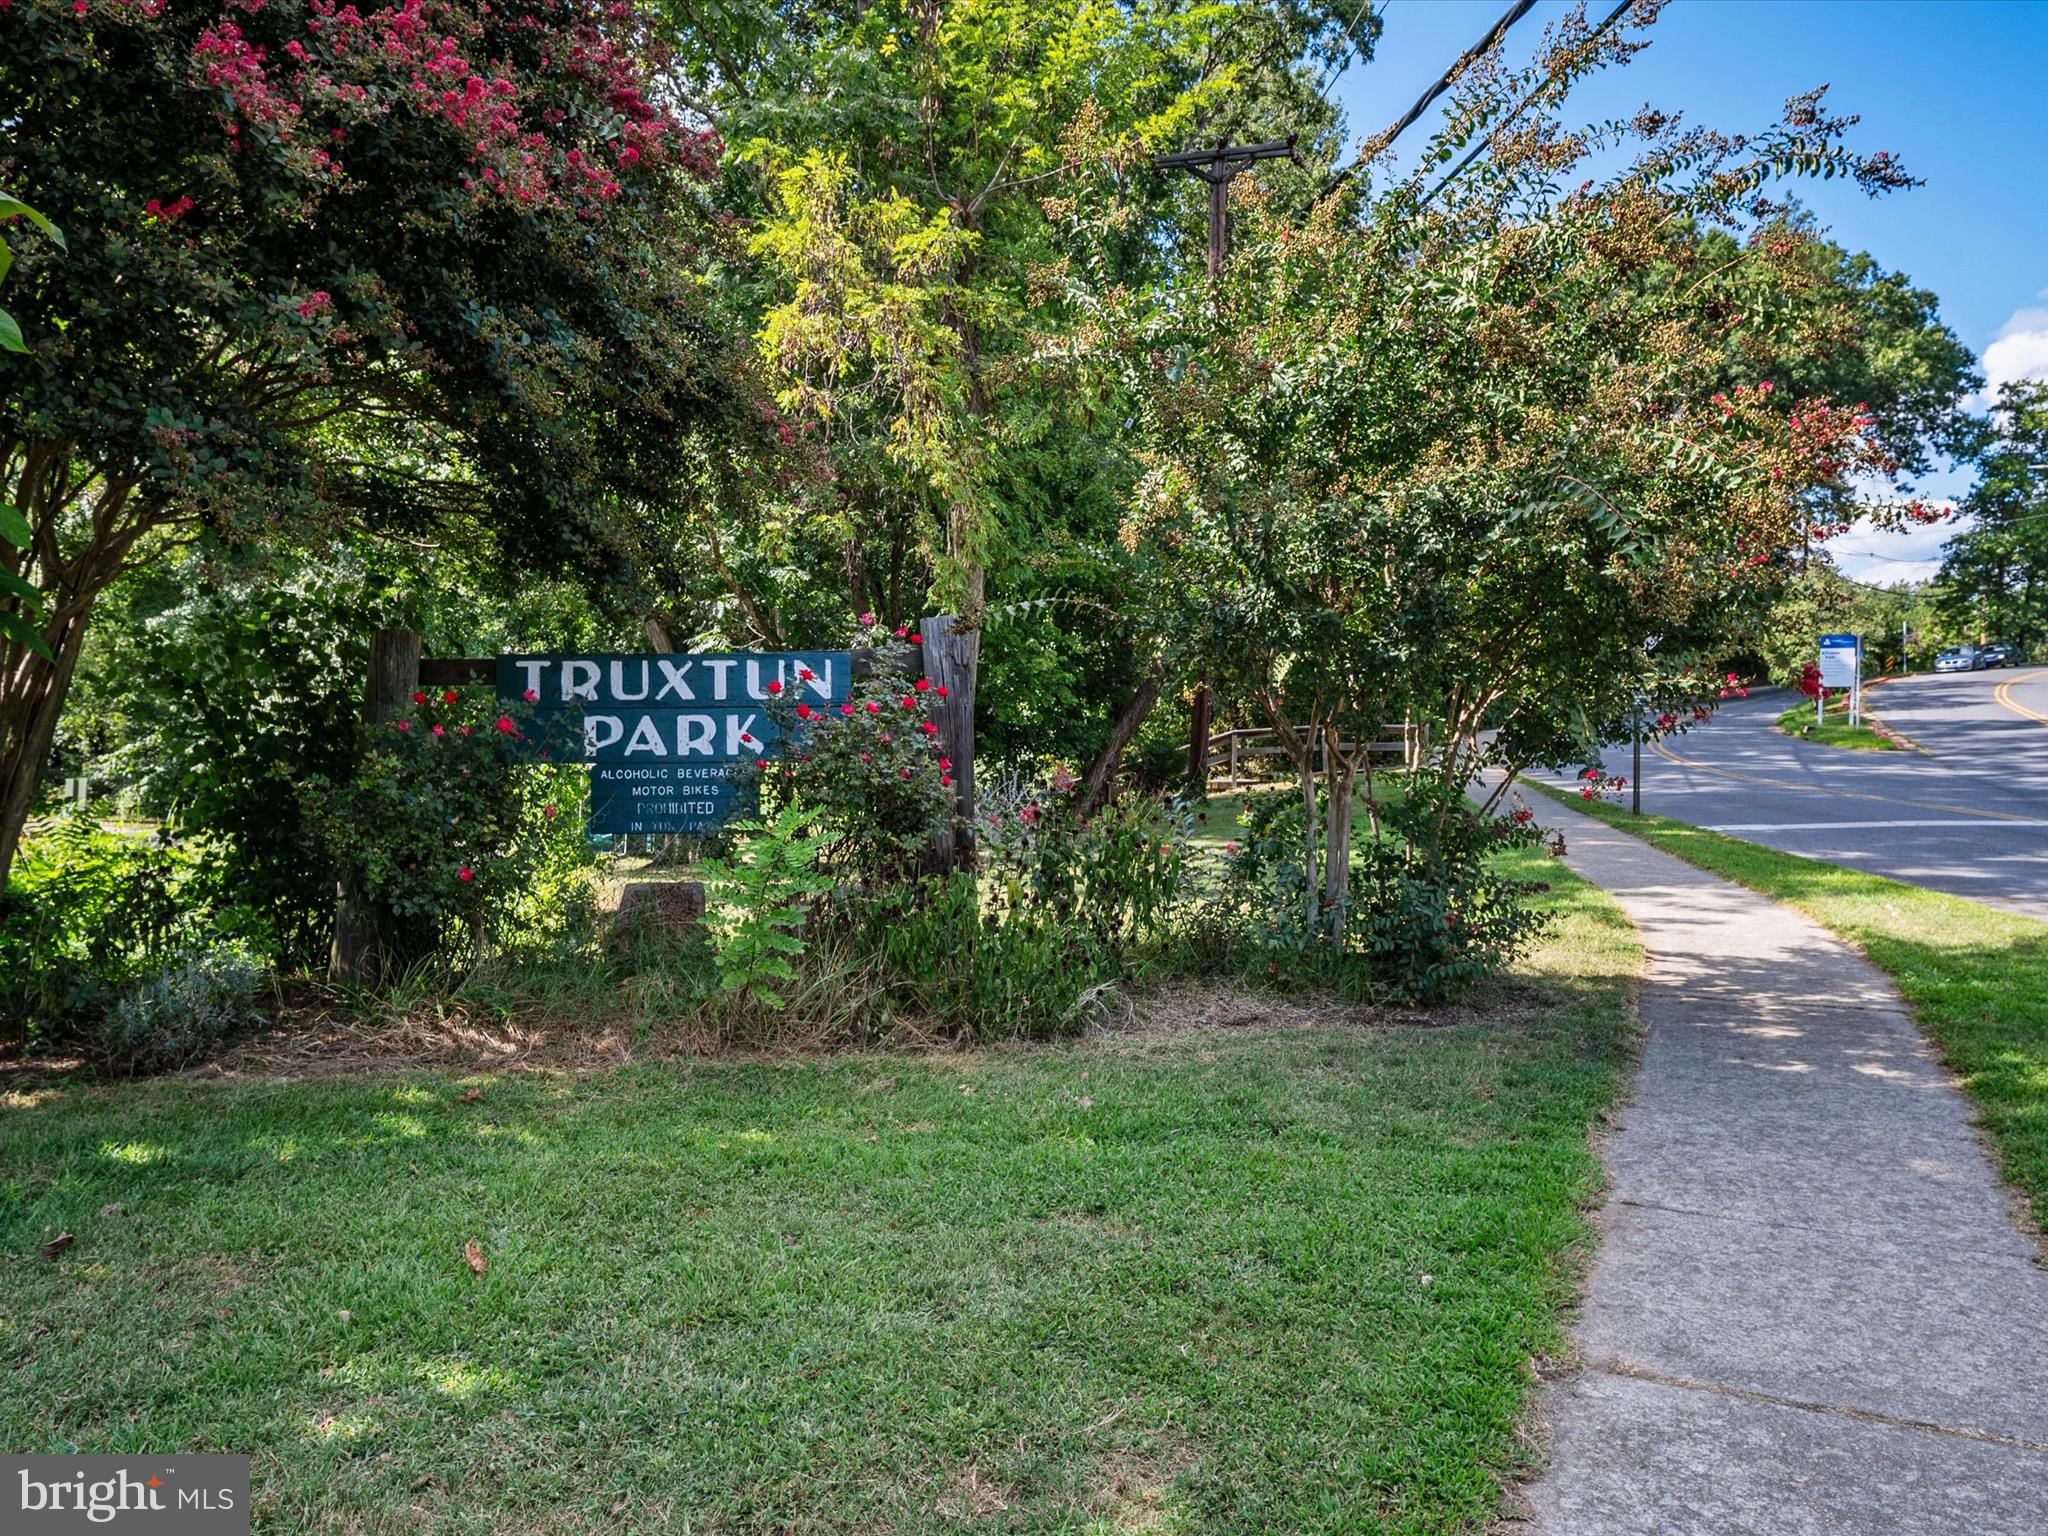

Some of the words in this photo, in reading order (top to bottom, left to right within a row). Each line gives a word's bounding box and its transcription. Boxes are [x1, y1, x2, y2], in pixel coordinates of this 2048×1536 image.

[516, 659, 832, 700] TRUXTUN
[583, 714, 764, 757] PARK
[600, 769, 668, 780] ALCOHOLIC
[677, 768, 737, 779] BEVERA
[632, 786, 674, 796] MOTOR
[683, 785, 719, 795] BIKES
[637, 802, 714, 815] PROHIBITED
[631, 822, 643, 832] IN
